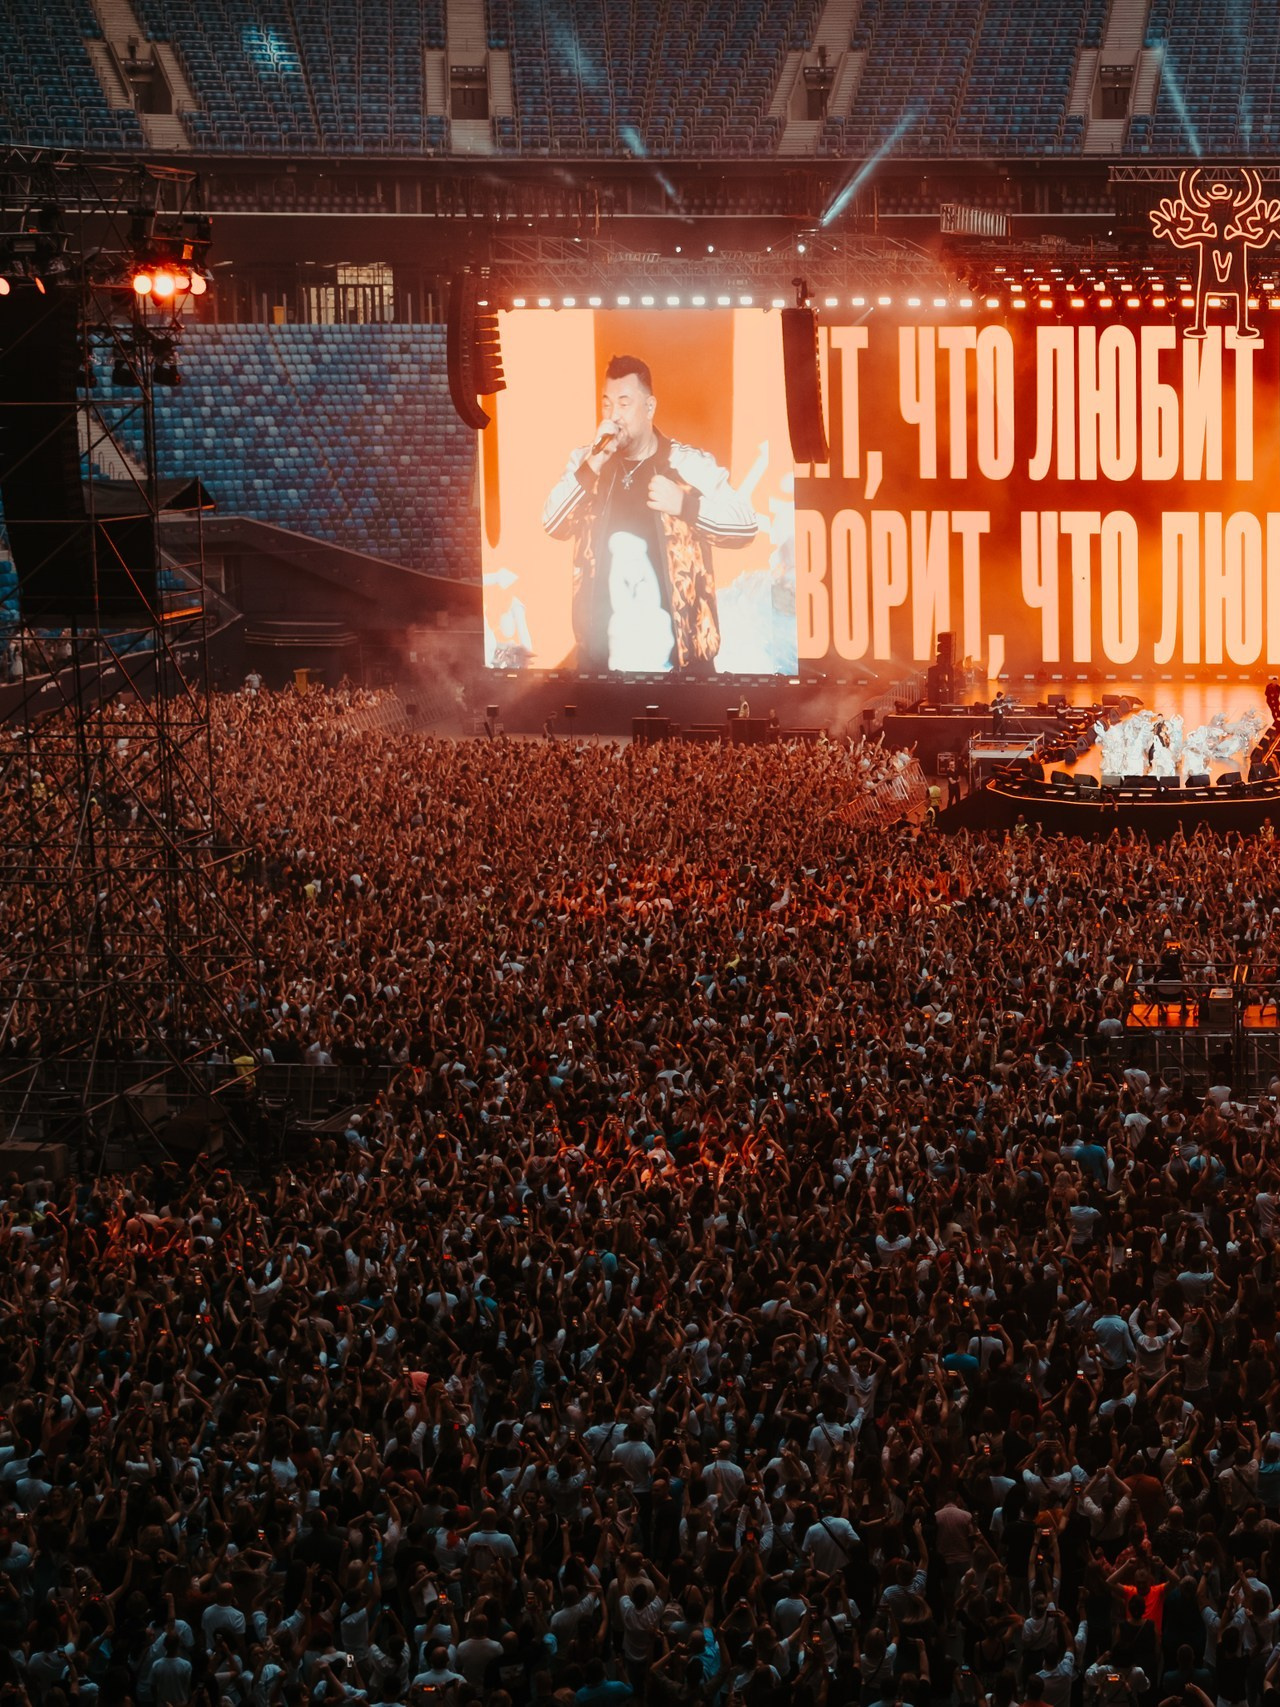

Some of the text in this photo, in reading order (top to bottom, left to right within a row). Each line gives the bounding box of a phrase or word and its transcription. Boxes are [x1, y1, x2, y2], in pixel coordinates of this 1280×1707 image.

[899, 325, 1015, 480] ЧТО
[1029, 325, 1265, 482] ЛЮБИТ
[794, 509, 1005, 681] ВОРИТ,
[1021, 510, 1139, 664] ЧТО
